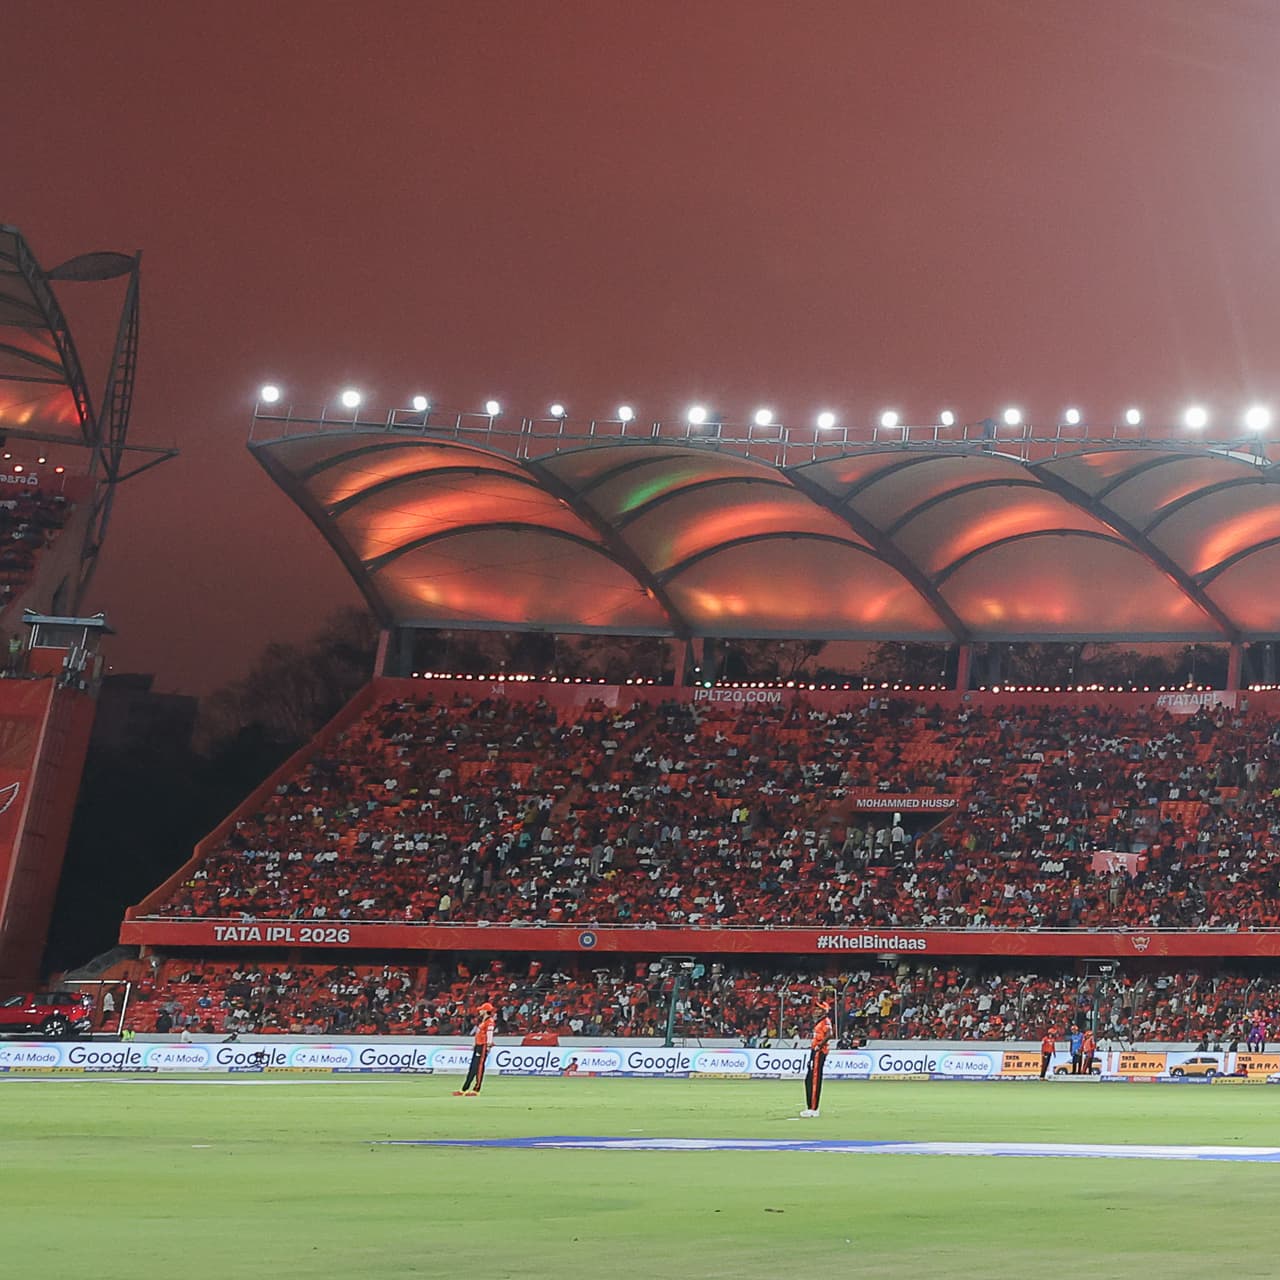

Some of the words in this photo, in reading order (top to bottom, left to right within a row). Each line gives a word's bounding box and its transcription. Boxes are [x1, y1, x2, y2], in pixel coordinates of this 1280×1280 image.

[694, 690, 781, 703] IPLT20.COM
[1157, 693, 1220, 706] #TATAIPL
[856, 799, 919, 808] MOHAMMED
[214, 926, 261, 941] TATA
[266, 927, 295, 942] IPL
[299, 928, 350, 943] 2026
[817, 934, 926, 951] #KhelBindaas
[26, 1053, 56, 1063] Mode
[68, 1046, 141, 1068] Google
[177, 1054, 205, 1063] Mode
[216, 1047, 286, 1068] Google
[322, 1055, 348, 1064] Mode
[360, 1049, 427, 1070] Google
[495, 1050, 560, 1071] Google
[594, 1057, 616, 1067] Mode
[628, 1052, 690, 1073] Google
[721, 1058, 745, 1067] Mode
[755, 1053, 813, 1074] Google
[845, 1061, 869, 1070] Mode
[878, 1055, 937, 1075] Google
[966, 1062, 989, 1071] Mode
